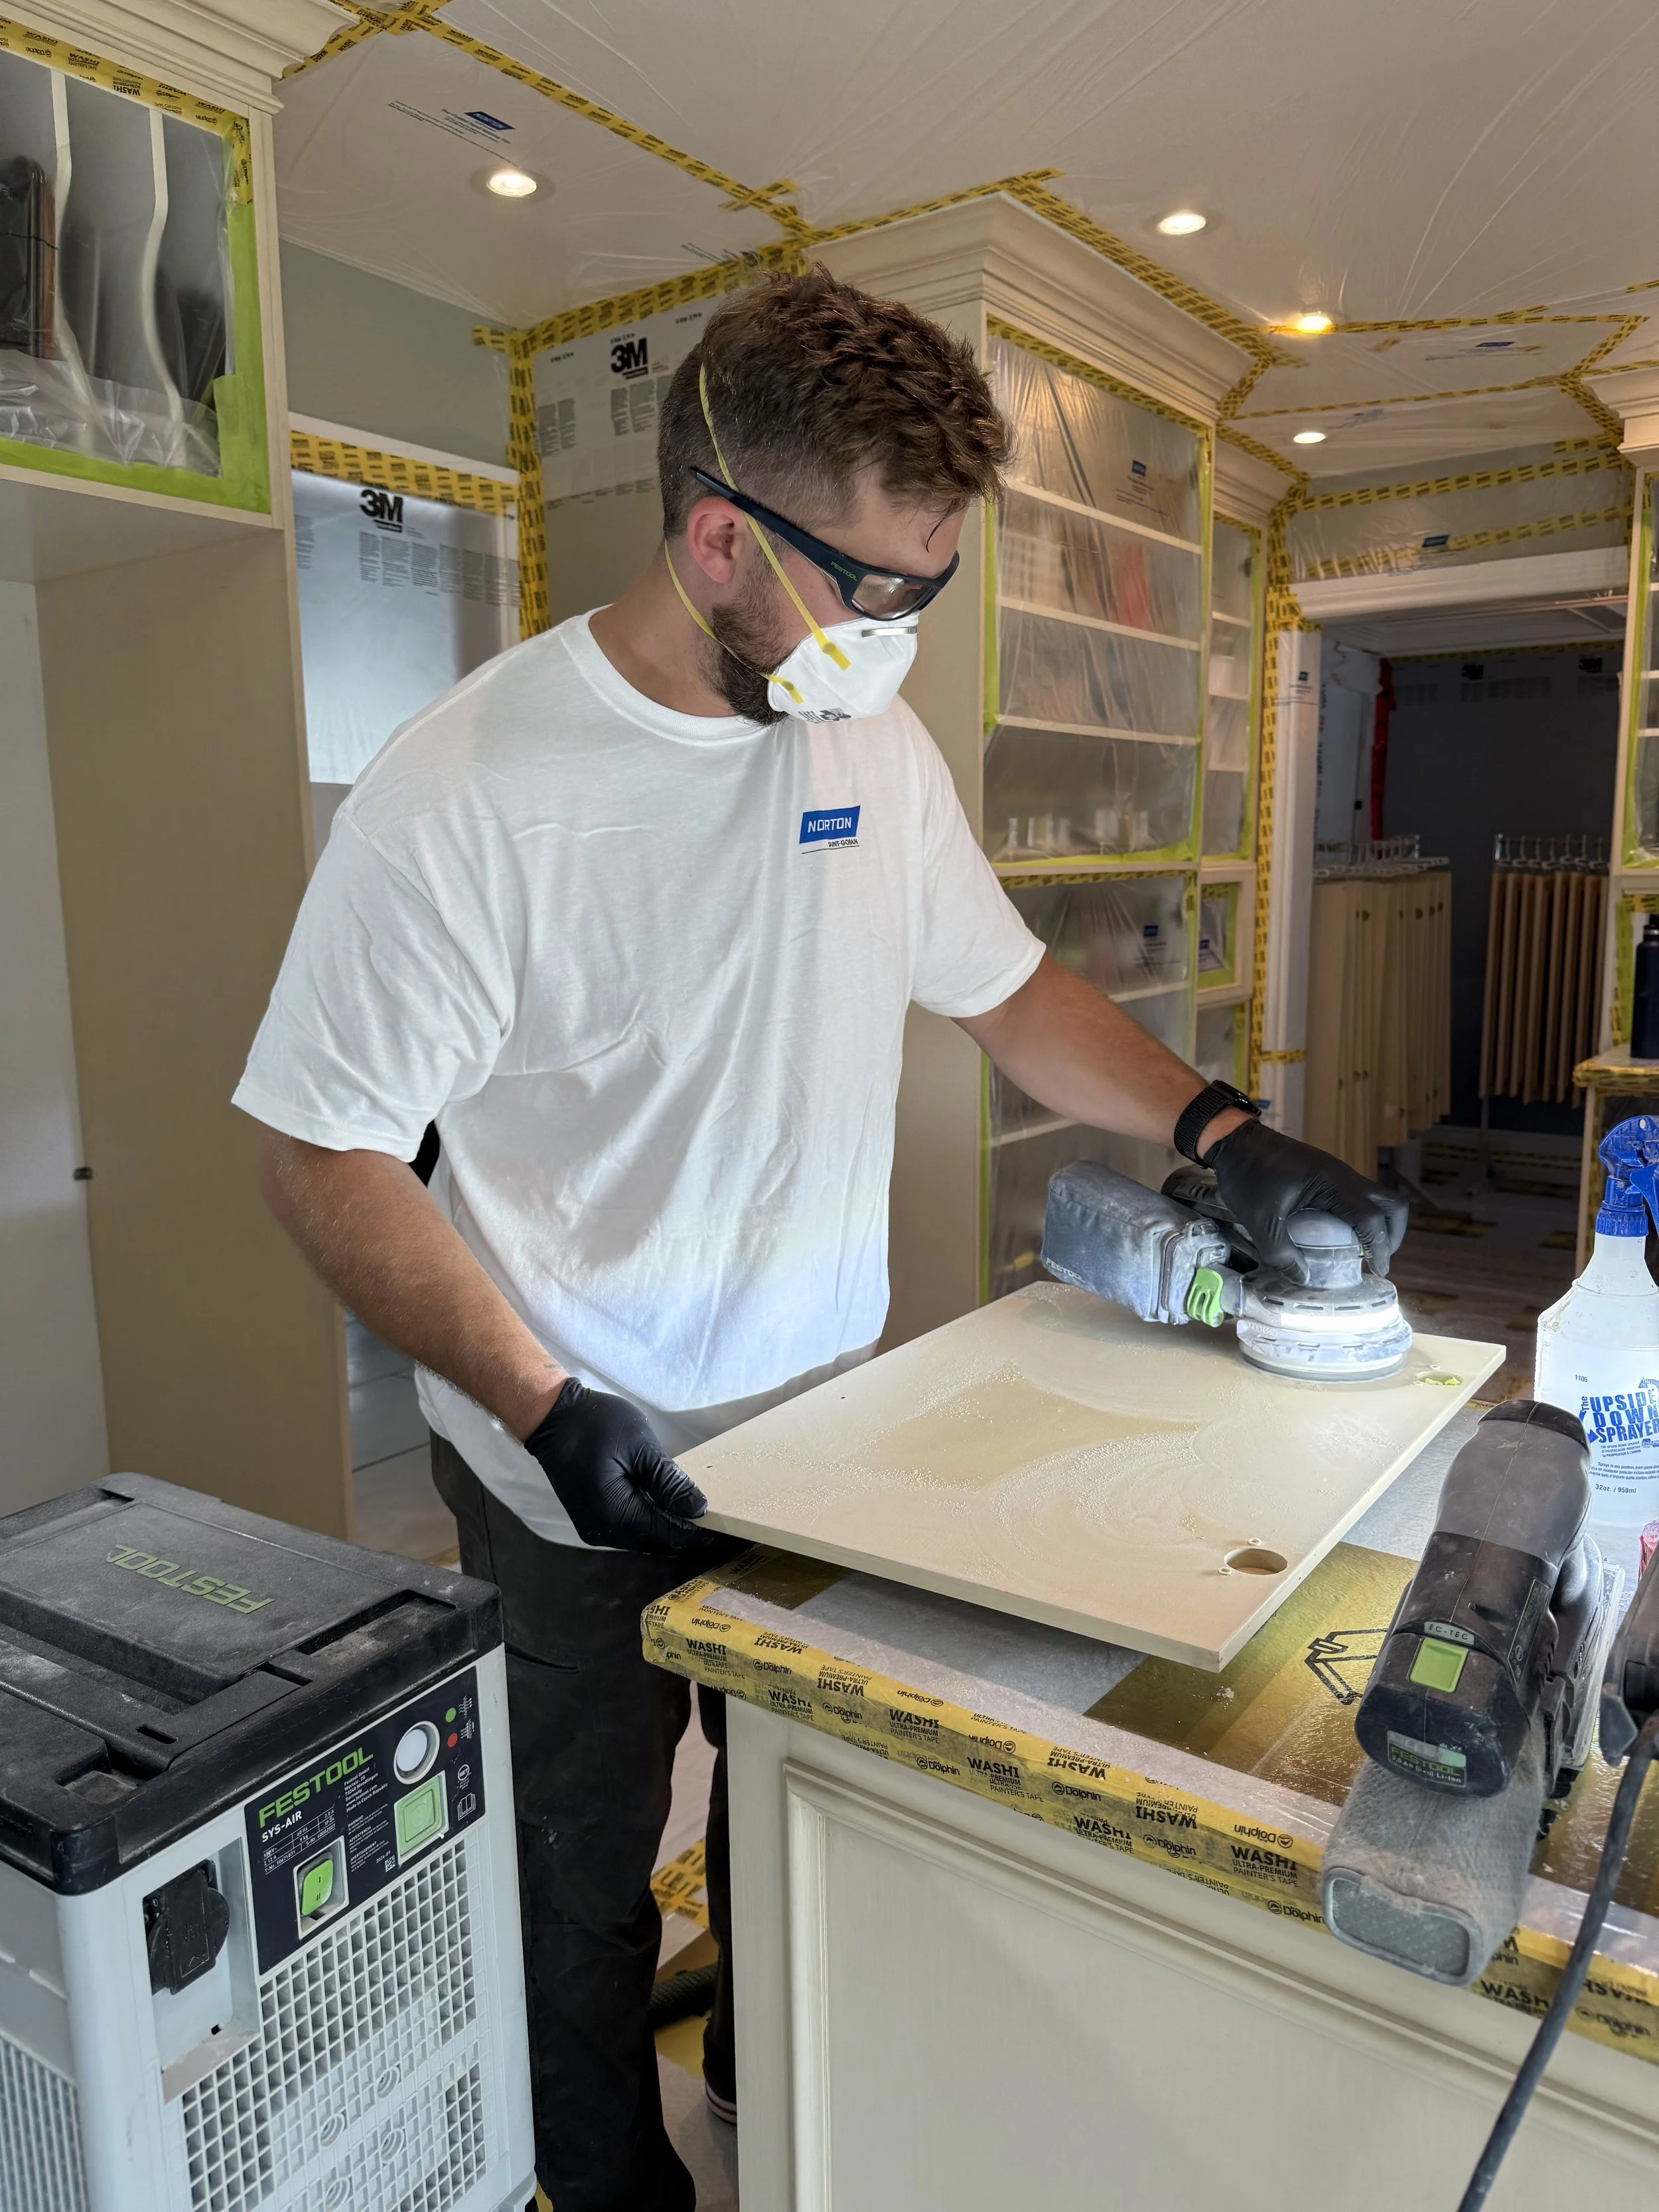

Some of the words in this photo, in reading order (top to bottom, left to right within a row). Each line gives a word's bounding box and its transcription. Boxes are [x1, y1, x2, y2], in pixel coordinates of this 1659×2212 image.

[113, 85, 141, 96] WASHI
[611, 337, 648, 373] 3M
[360, 489, 403, 522] 3M
[831, 561, 858, 581] FESTOOL
[808, 817, 852, 833] NORTON
[1581, 1396, 1590, 1413] The
[1589, 1389, 1658, 1412] UPSIDE
[1593, 1405, 1659, 1428] DOWN
[1596, 1418, 1659, 1443] SPRAYER
[106, 1544, 275, 1614] FESTOOL
[691, 1617, 721, 1629] Dolphin
[1429, 1624, 1469, 1640] EC-TEC
[686, 1638, 727, 1655] WASHI
[754, 1637, 803, 1655] WASHI
[760, 1634, 808, 1649] ULTRA-PREMIUM
[666, 1651, 682, 1660] phin
[687, 1649, 727, 1662] ULTRA-PREMIUM
[705, 1666, 731, 1676] PAINTER'S
[763, 1660, 792, 1675] Dolphin
[821, 1664, 838, 1674] TAPE
[839, 1668, 872, 1680] PAINTER'S
[819, 1671, 869, 1685] ULTRA-PREMIUM
[817, 1678, 865, 1697] WASHI
[897, 1690, 930, 1703] Dolphin
[770, 1701, 813, 1715] ULTRA-PREMIUM
[771, 1707, 799, 1718] PAINTER'S
[800, 1712, 814, 1721] TAPE
[833, 1706, 863, 1720] Dolphin
[889, 1709, 940, 1729] WASHI
[970, 1716, 1006, 1730] PAINTER'S
[890, 1721, 938, 1736] ULTRA-PREMIUM
[891, 1728, 922, 1740] PAINTER'S
[922, 1735, 940, 1744] TAPE
[1050, 1750, 1111, 1769] ULTRA-PREMIUM
[1052, 1746, 1074, 1756] TAPE
[929, 1761, 960, 1776] Dolphin
[968, 1756, 1020, 1779] WASHI
[1047, 1757, 1106, 1781] WASHI
[1391, 1746, 1461, 1777] FESTOOL
[344, 1773, 358, 1787] Festool
[1436, 1771, 1462, 1783] Li-Ion
[258, 1747, 374, 1828] FESTOOL
[345, 1789, 362, 1802] Germany
[990, 1785, 1025, 1798] PAINTER'S
[1066, 1785, 1102, 1802] Dolphin
[346, 1803, 357, 1813] Made
[1135, 1805, 1198, 1830] WASHI
[262, 1810, 303, 1844] SYS-AIR
[1234, 1823, 1276, 1843] Dolphin
[1076, 1828, 1132, 1848] ULTRA-PREMIUM
[1117, 1844, 1135, 1854] TAPE
[1158, 1839, 1196, 1856] Dolphin
[1231, 1845, 1297, 1871] WASHI
[1232, 1859, 1298, 1879] ULTRA-PREMIUM
[1234, 1867, 1275, 1882] PAINTER'S
[1277, 1876, 1299, 1887] TAPE
[1283, 1904, 1325, 1924] Dolphin
